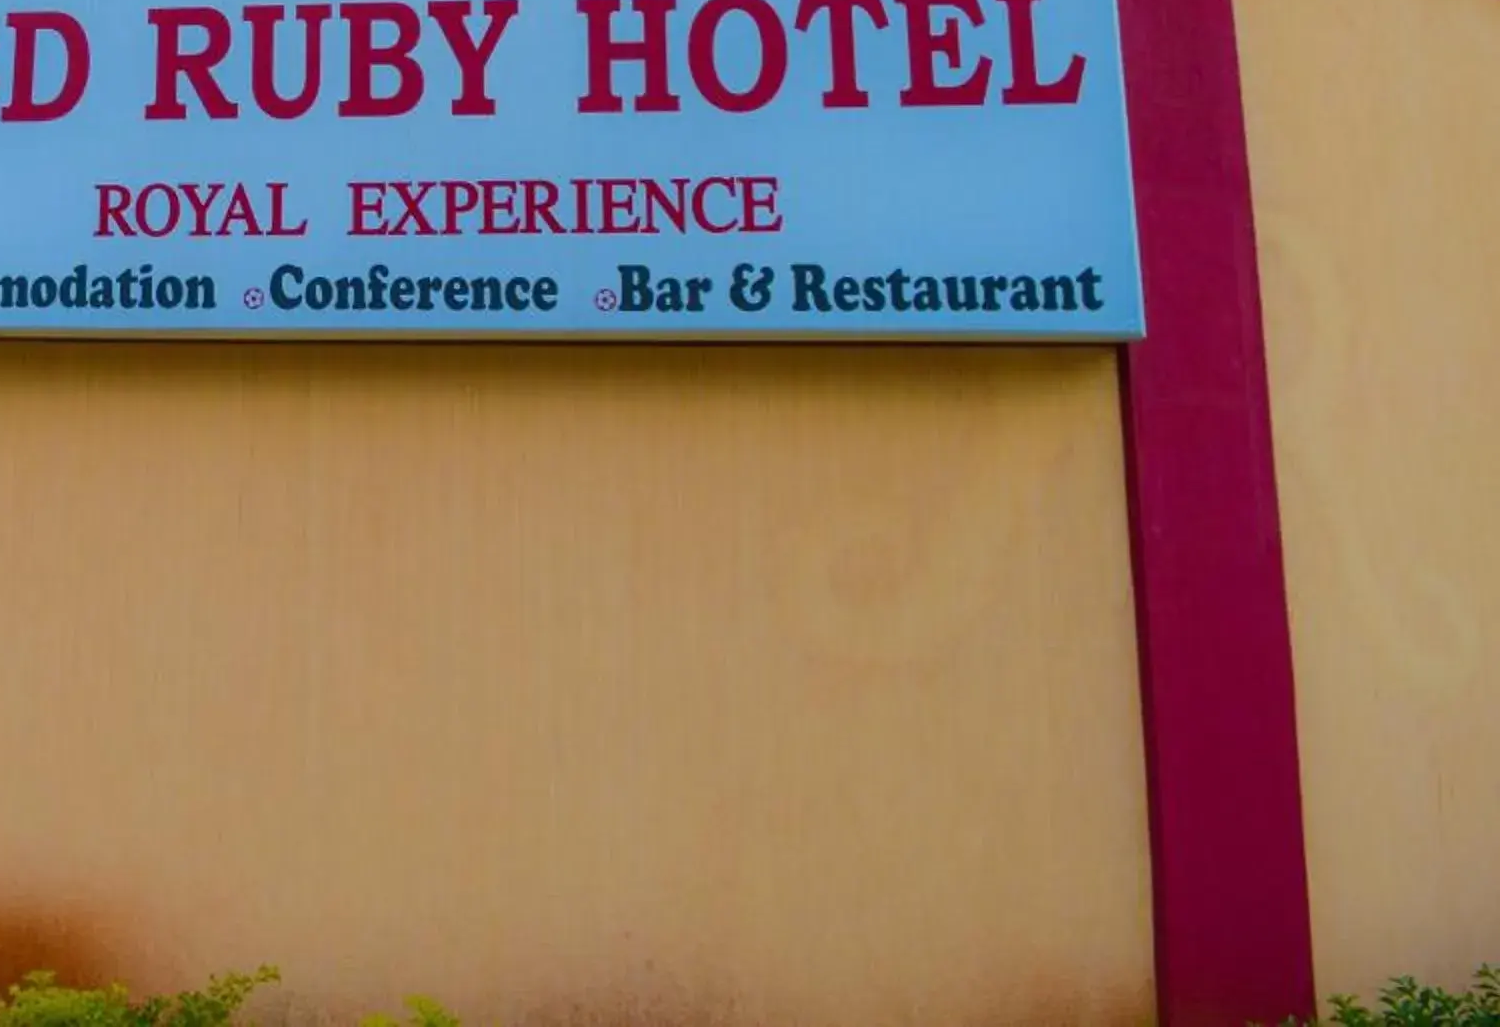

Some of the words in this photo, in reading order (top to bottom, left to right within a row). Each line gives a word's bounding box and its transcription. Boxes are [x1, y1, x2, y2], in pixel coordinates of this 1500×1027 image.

[92, 181, 309, 238] ROYAL
[346, 175, 784, 237] EXPERIENCE
[268, 263, 559, 312] Conference
[617, 264, 714, 314] Bar
[728, 262, 775, 314] &
[790, 263, 1105, 314] Restaurant
